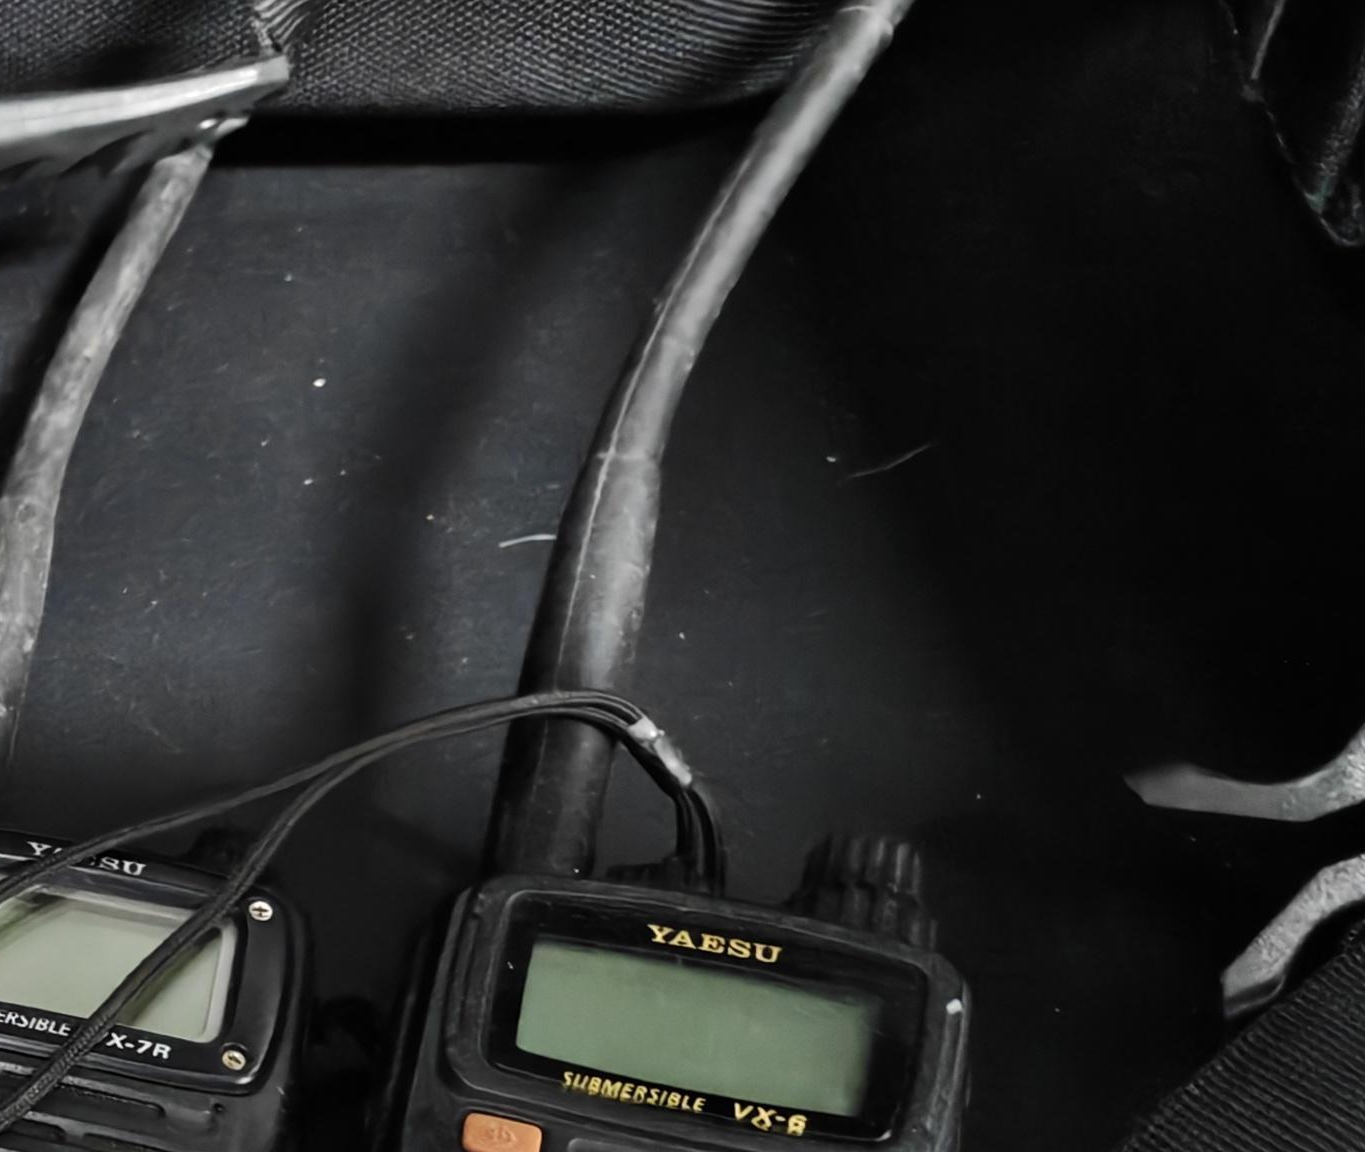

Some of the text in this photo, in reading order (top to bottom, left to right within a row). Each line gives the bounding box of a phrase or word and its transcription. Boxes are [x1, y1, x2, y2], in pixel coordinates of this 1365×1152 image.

[27, 841, 146, 875] YSU
[646, 923, 782, 964] YAESU
[105, 1032, 173, 1060] X-7R
[562, 1071, 706, 1113] SUBMERSIBLE
